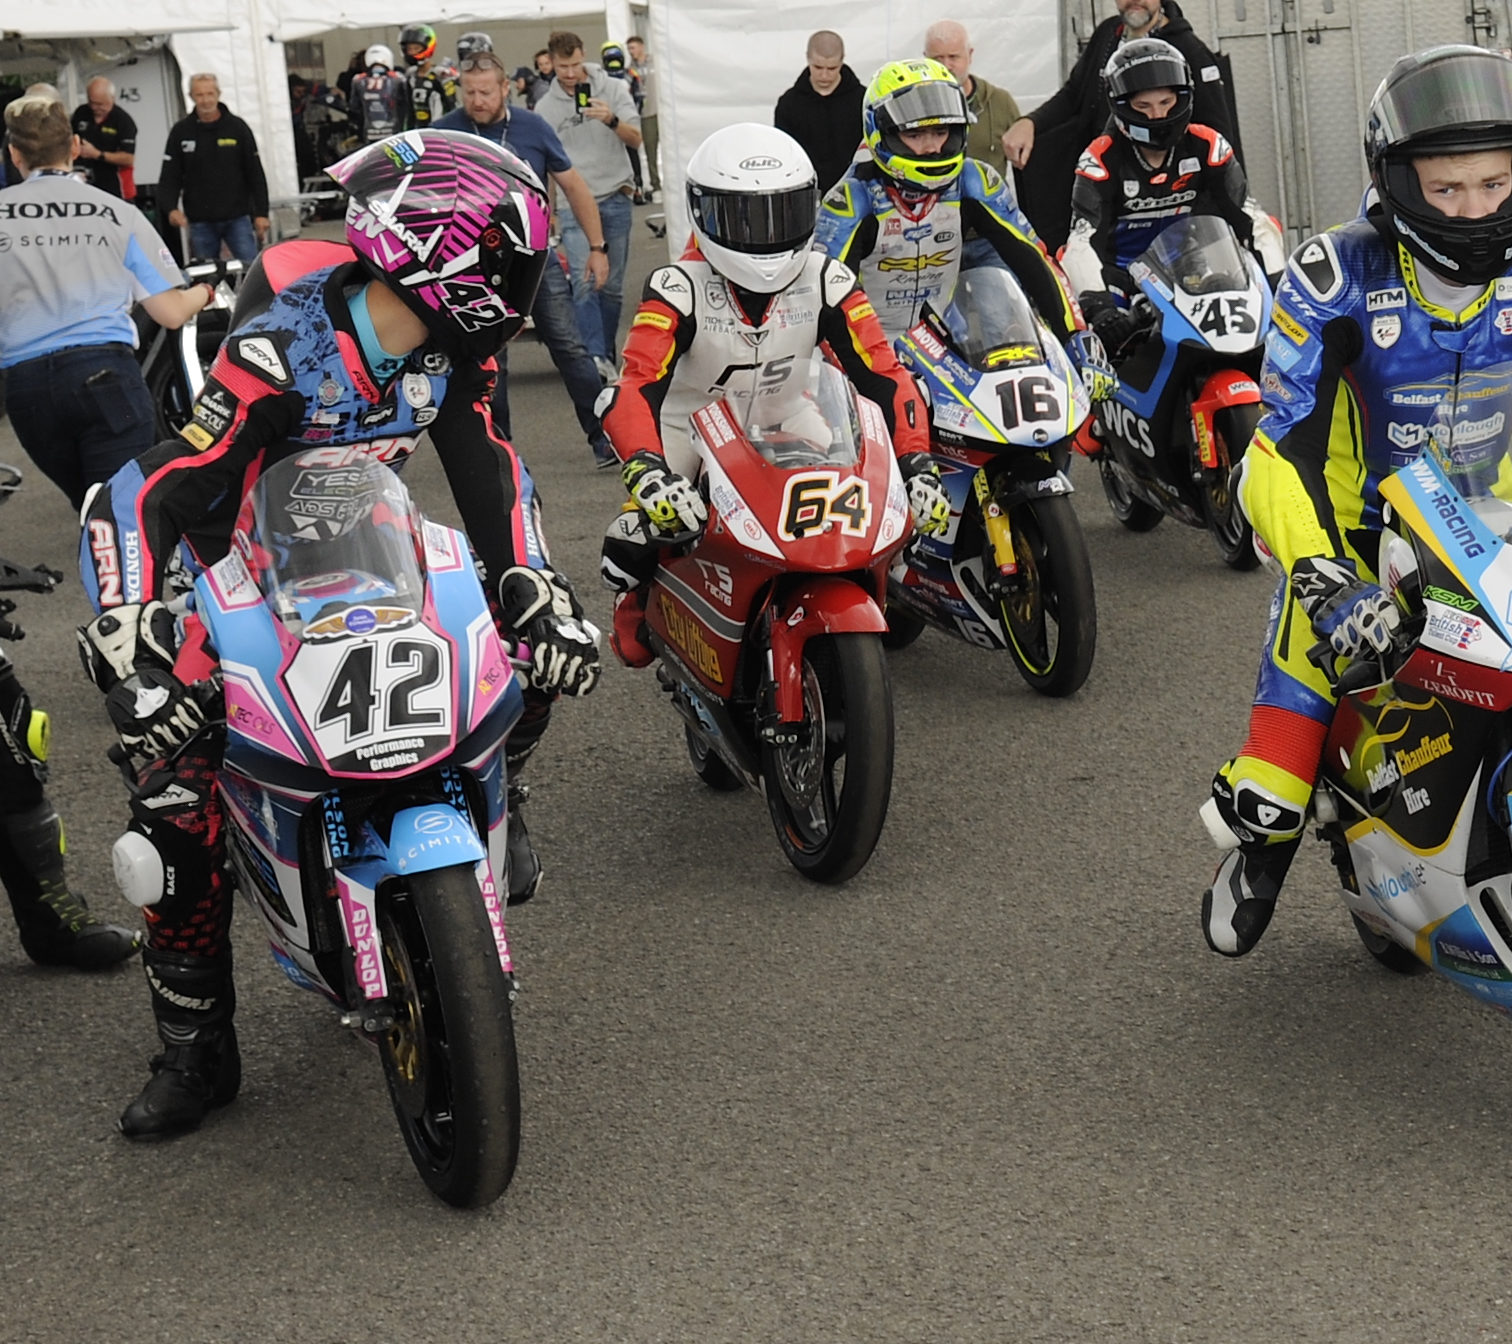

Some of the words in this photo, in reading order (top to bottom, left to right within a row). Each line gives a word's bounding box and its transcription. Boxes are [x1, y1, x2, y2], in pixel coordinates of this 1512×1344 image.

[120, 88, 141, 102] 43
[369, 199, 430, 262] SHARK
[878, 249, 955, 272] RK
[439, 280, 507, 333] 42
[1368, 292, 1404, 305] HTM
[243, 342, 280, 369] ARN
[911, 326, 946, 359] MOTUL
[352, 370, 380, 402] ARN
[1392, 393, 1443, 405] Belfast
[995, 376, 1061, 431] 16
[1102, 401, 1155, 458] WCS
[295, 436, 421, 468] ARN
[784, 477, 867, 536] 64
[89, 518, 124, 606] ARN
[125, 529, 142, 605] HONDA
[1422, 585, 1480, 612] KSM
[1428, 615, 1463, 635] British
[315, 637, 445, 743] 42
[1419, 677, 1496, 707] ZEROFIT
[355, 737, 426, 761] Performance
[370, 752, 419, 772] Graphics
[1365, 758, 1401, 794] Belfast
[1395, 731, 1454, 777] Chauffeur
[1402, 786, 1432, 816] Hire
[166, 864, 176, 896] RACE
[352, 908, 380, 997] DUNLOP
